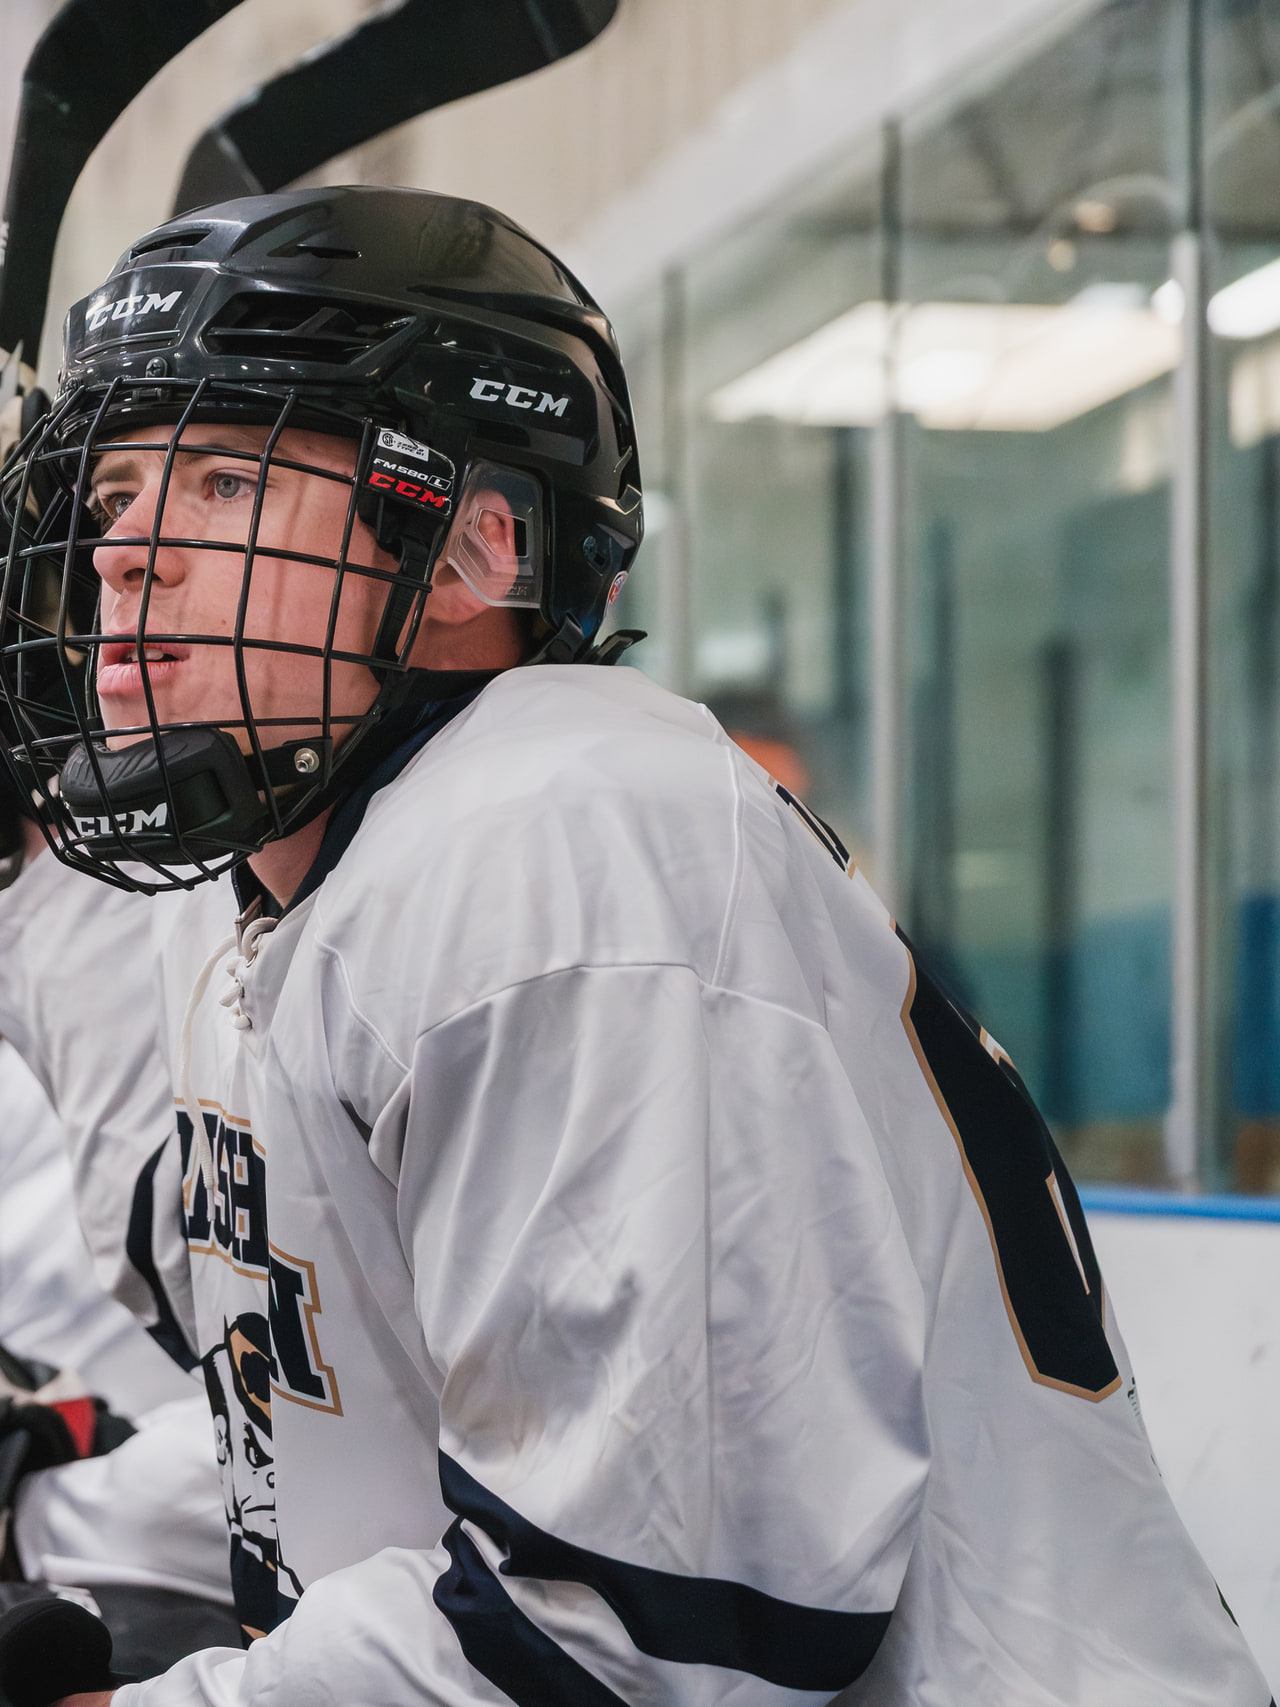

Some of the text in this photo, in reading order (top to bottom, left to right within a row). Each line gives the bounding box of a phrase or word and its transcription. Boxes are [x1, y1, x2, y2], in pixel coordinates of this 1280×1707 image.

[87, 291, 183, 332] CCM
[469, 377, 569, 417] CCM
[369, 471, 447, 508] CCM
[373, 458, 443, 487] FM580 L
[73, 802, 168, 836] CCM
